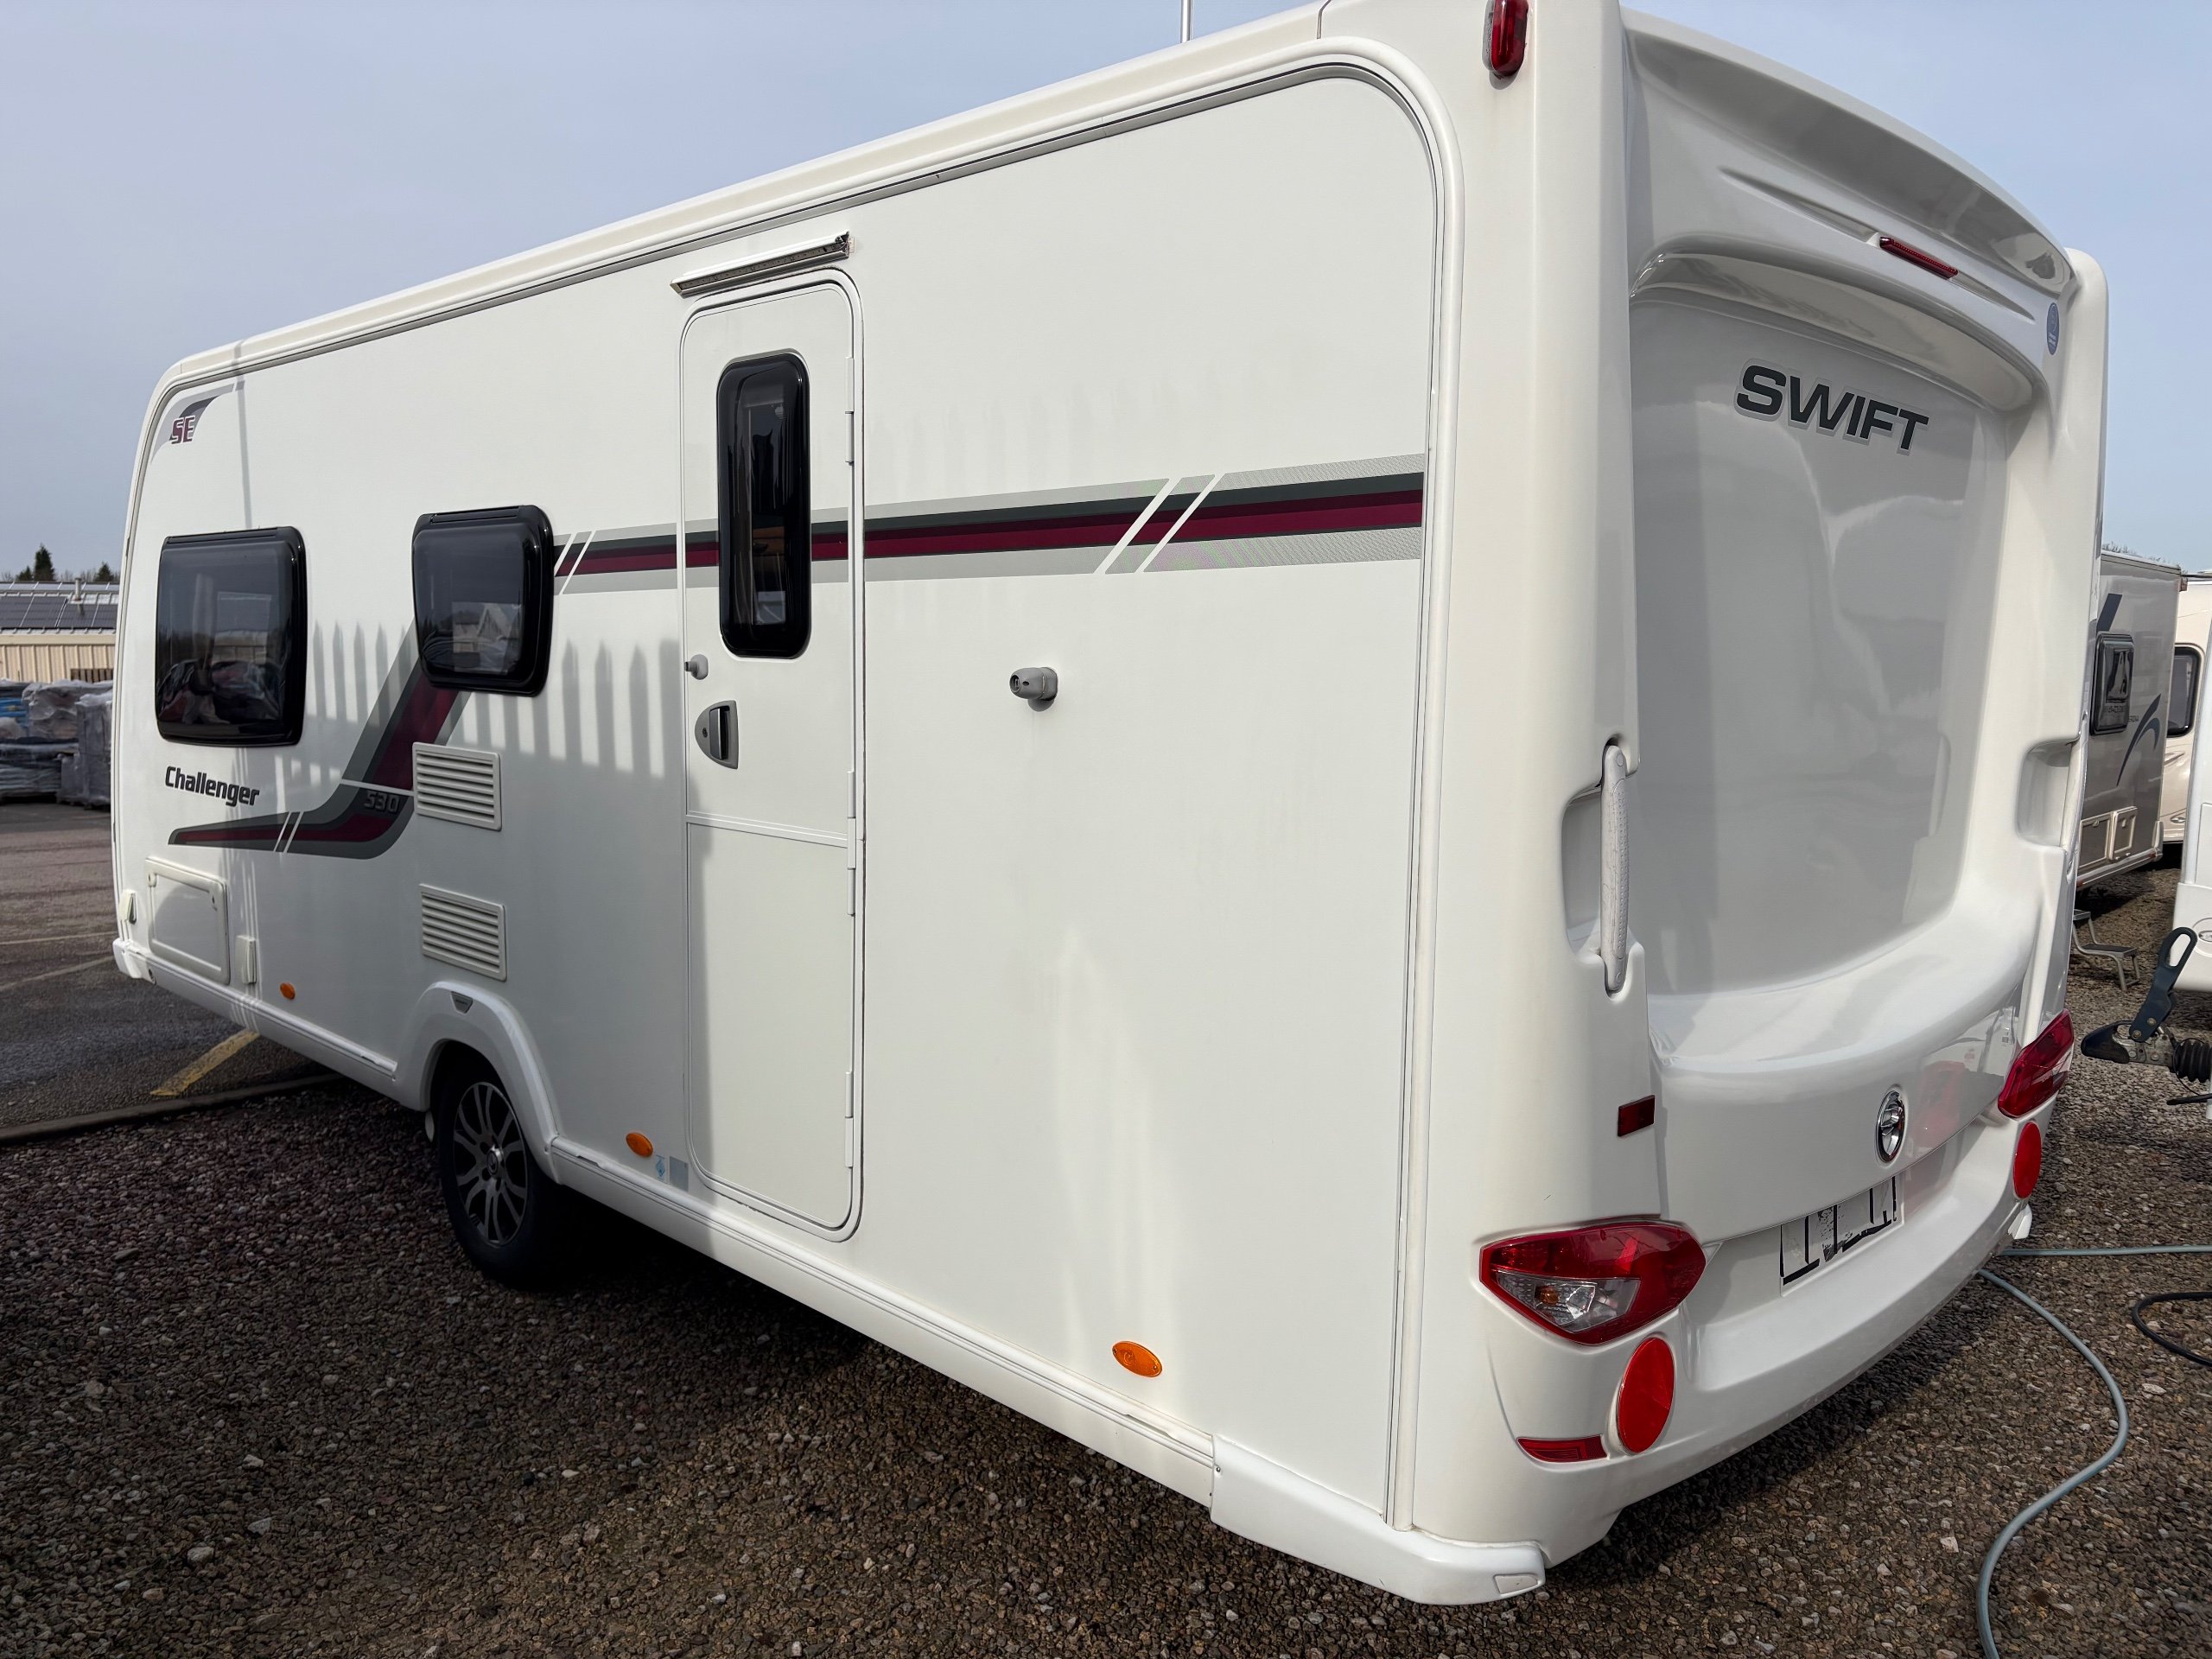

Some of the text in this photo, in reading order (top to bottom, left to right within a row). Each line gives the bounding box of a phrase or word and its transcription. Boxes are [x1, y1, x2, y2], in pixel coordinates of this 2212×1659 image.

[1736, 365, 1929, 450] SWIFT
[170, 416, 195, 444] SE
[165, 766, 260, 807] Challenger
[364, 790, 399, 812] 530
